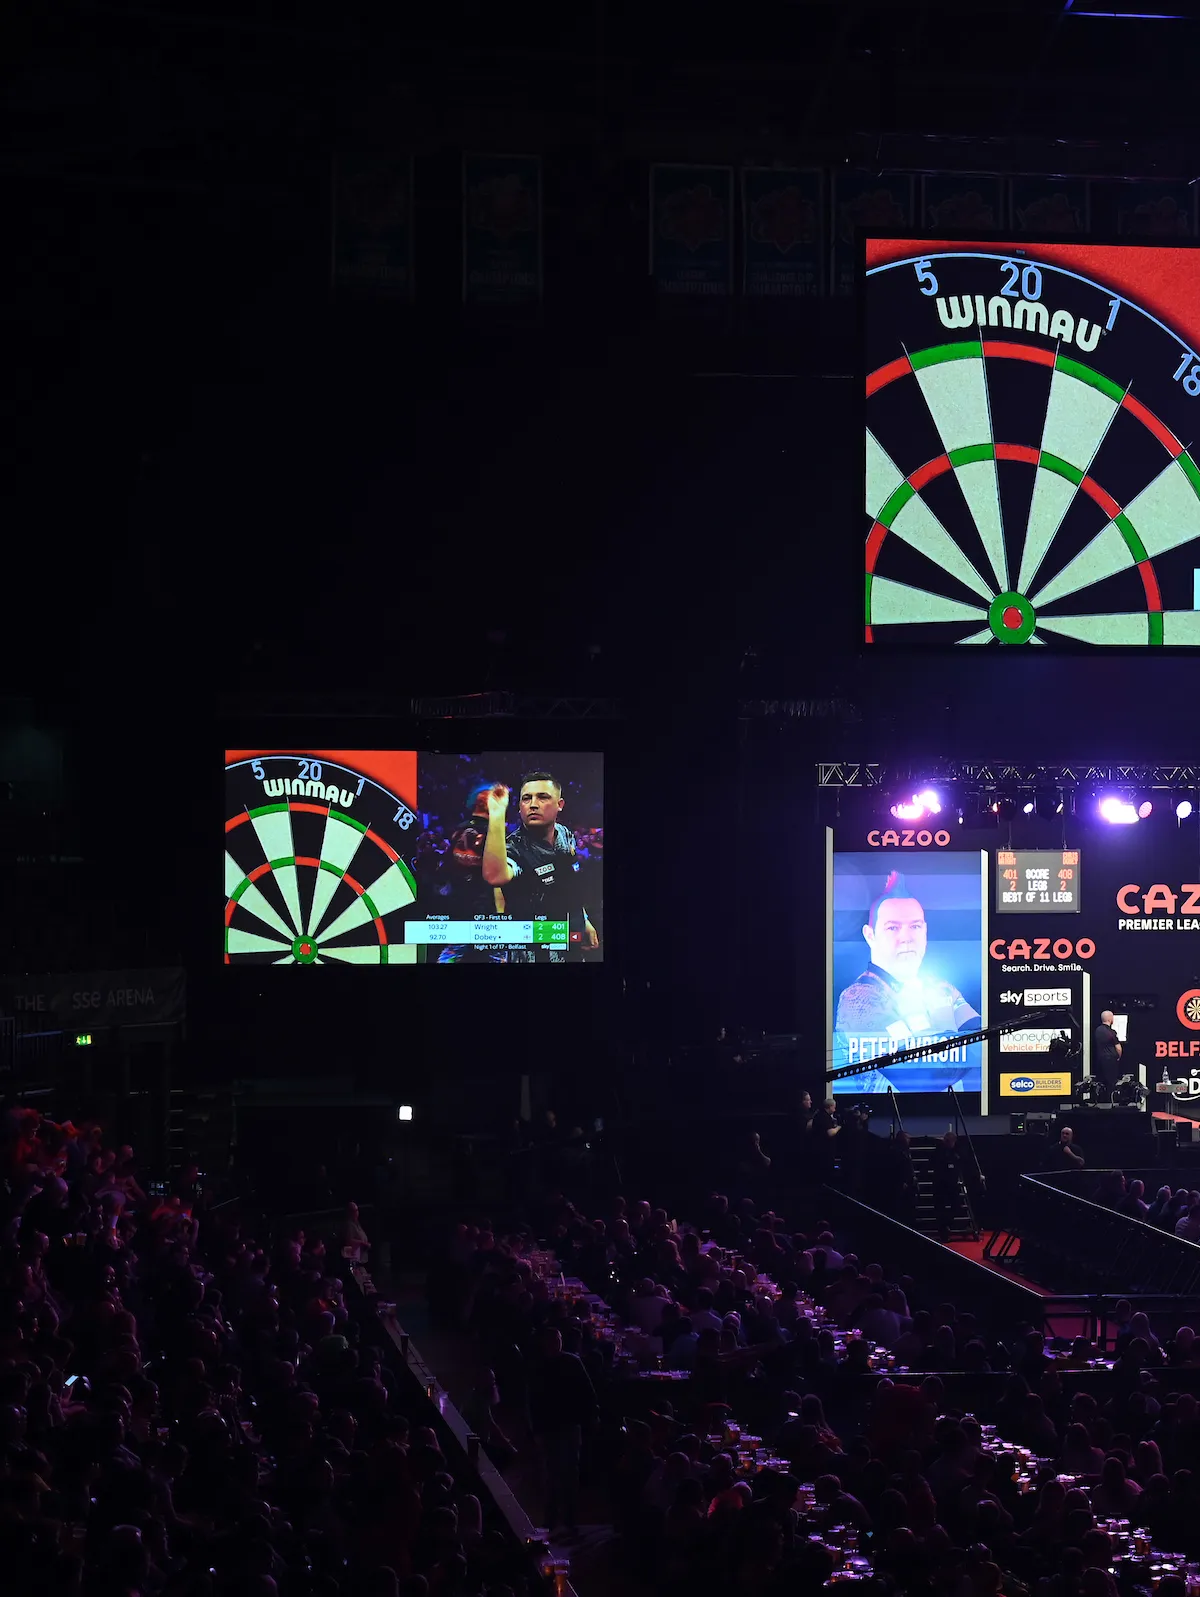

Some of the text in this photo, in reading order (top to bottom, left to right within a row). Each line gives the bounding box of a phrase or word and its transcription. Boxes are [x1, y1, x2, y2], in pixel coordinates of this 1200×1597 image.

[914, 261, 939, 296] 5
[1000, 261, 1042, 301] 20
[936, 295, 1102, 352] WINMAU
[1105, 299, 1120, 331] 1
[251, 760, 265, 780] 5
[298, 760, 322, 781] 20
[263, 778, 355, 808] WINMAU
[356, 778, 365, 796] 1
[393, 805, 414, 830] 18
[867, 829, 951, 847] CAZOO
[1003, 869, 1018, 879] 401
[1025, 868, 1050, 879] SCORE
[1058, 869, 1073, 879] 408
[1010, 881, 1016, 891] 2
[1027, 880, 1048, 891] LEGS
[1060, 880, 1066, 891] 2
[1002, 892, 1073, 902] BEST OF 11 LEGS
[1118, 919, 1174, 930] PREMIER
[989, 938, 1096, 960] CAZOO
[1001, 963, 1083, 972] Search. Drive. Smile.
[15, 994, 46, 1011] THE
[106, 986, 155, 1008] ARENA
[1000, 990, 1068, 1006] sky sports
[1003, 1030, 1057, 1043] moneyb
[849, 1036, 898, 1063] PETER
[1011, 1080, 1034, 1088] selco
